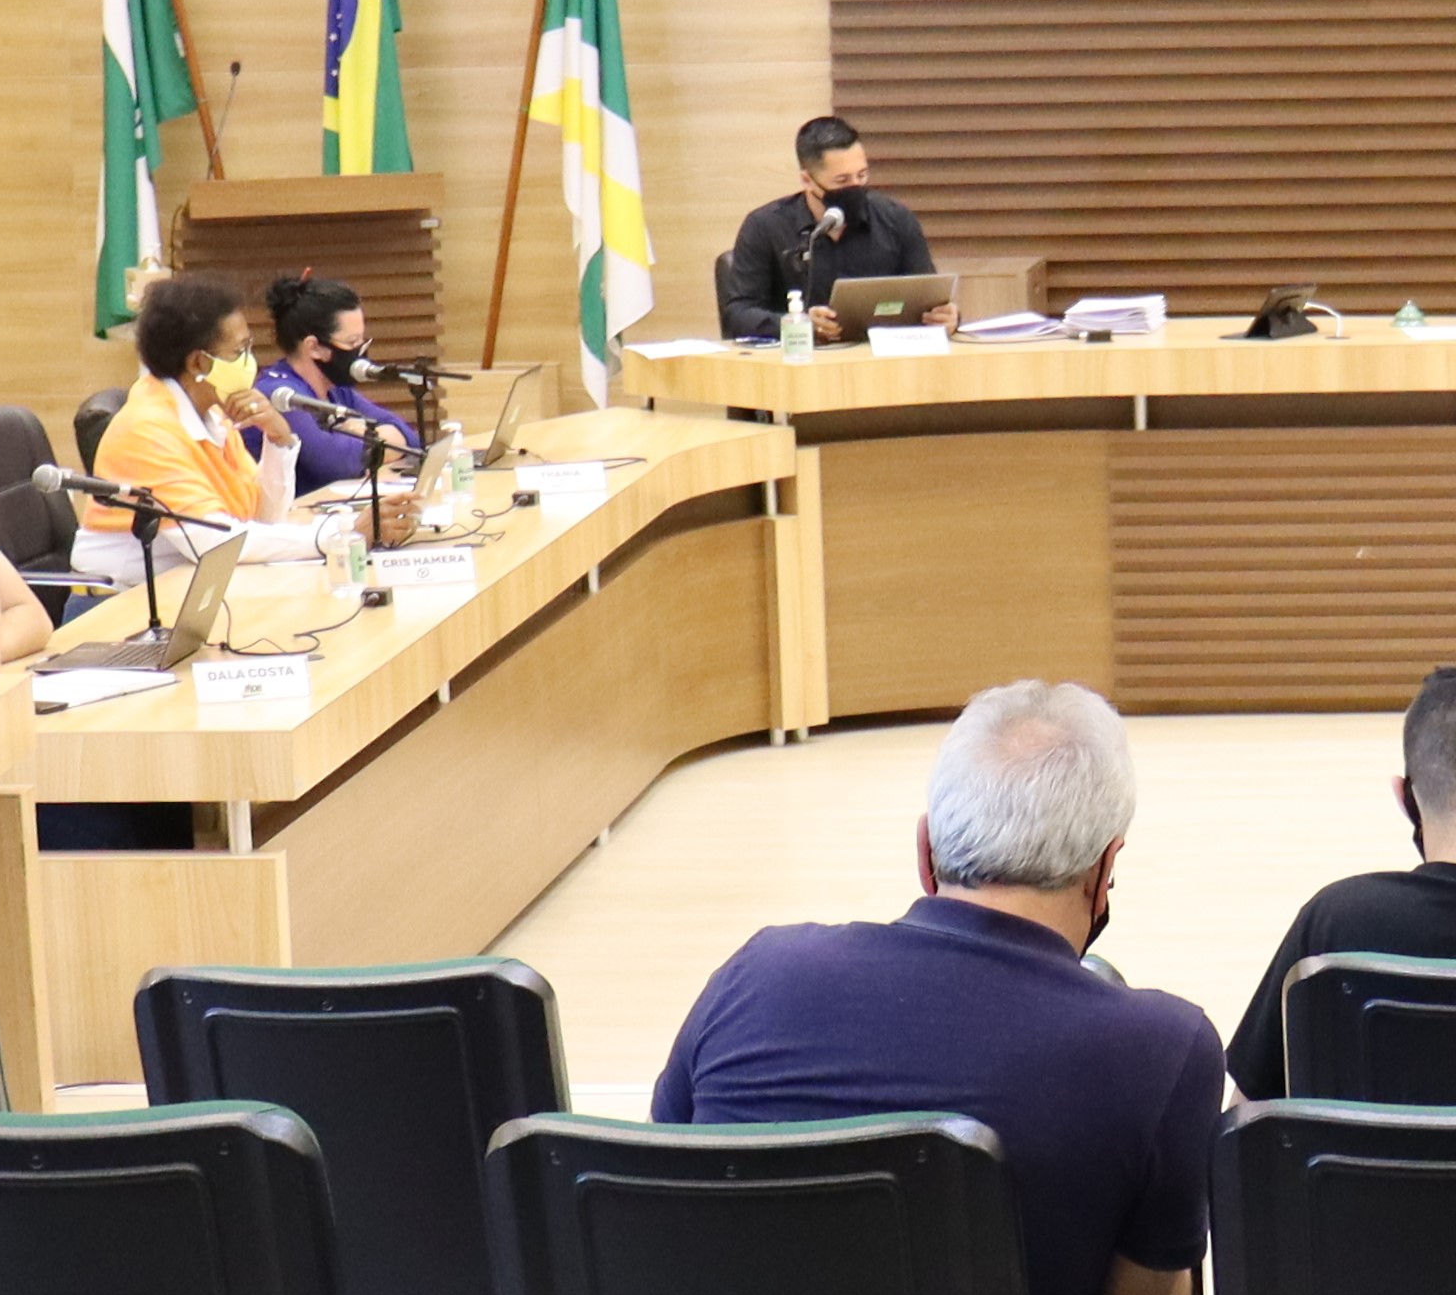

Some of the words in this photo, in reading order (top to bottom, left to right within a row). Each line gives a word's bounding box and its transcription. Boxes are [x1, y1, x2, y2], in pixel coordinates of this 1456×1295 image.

[381, 558, 412, 569] CRIS
[412, 554, 467, 566] HAMERA
[207, 669, 246, 682] DALA
[247, 666, 295, 679] COSTA
